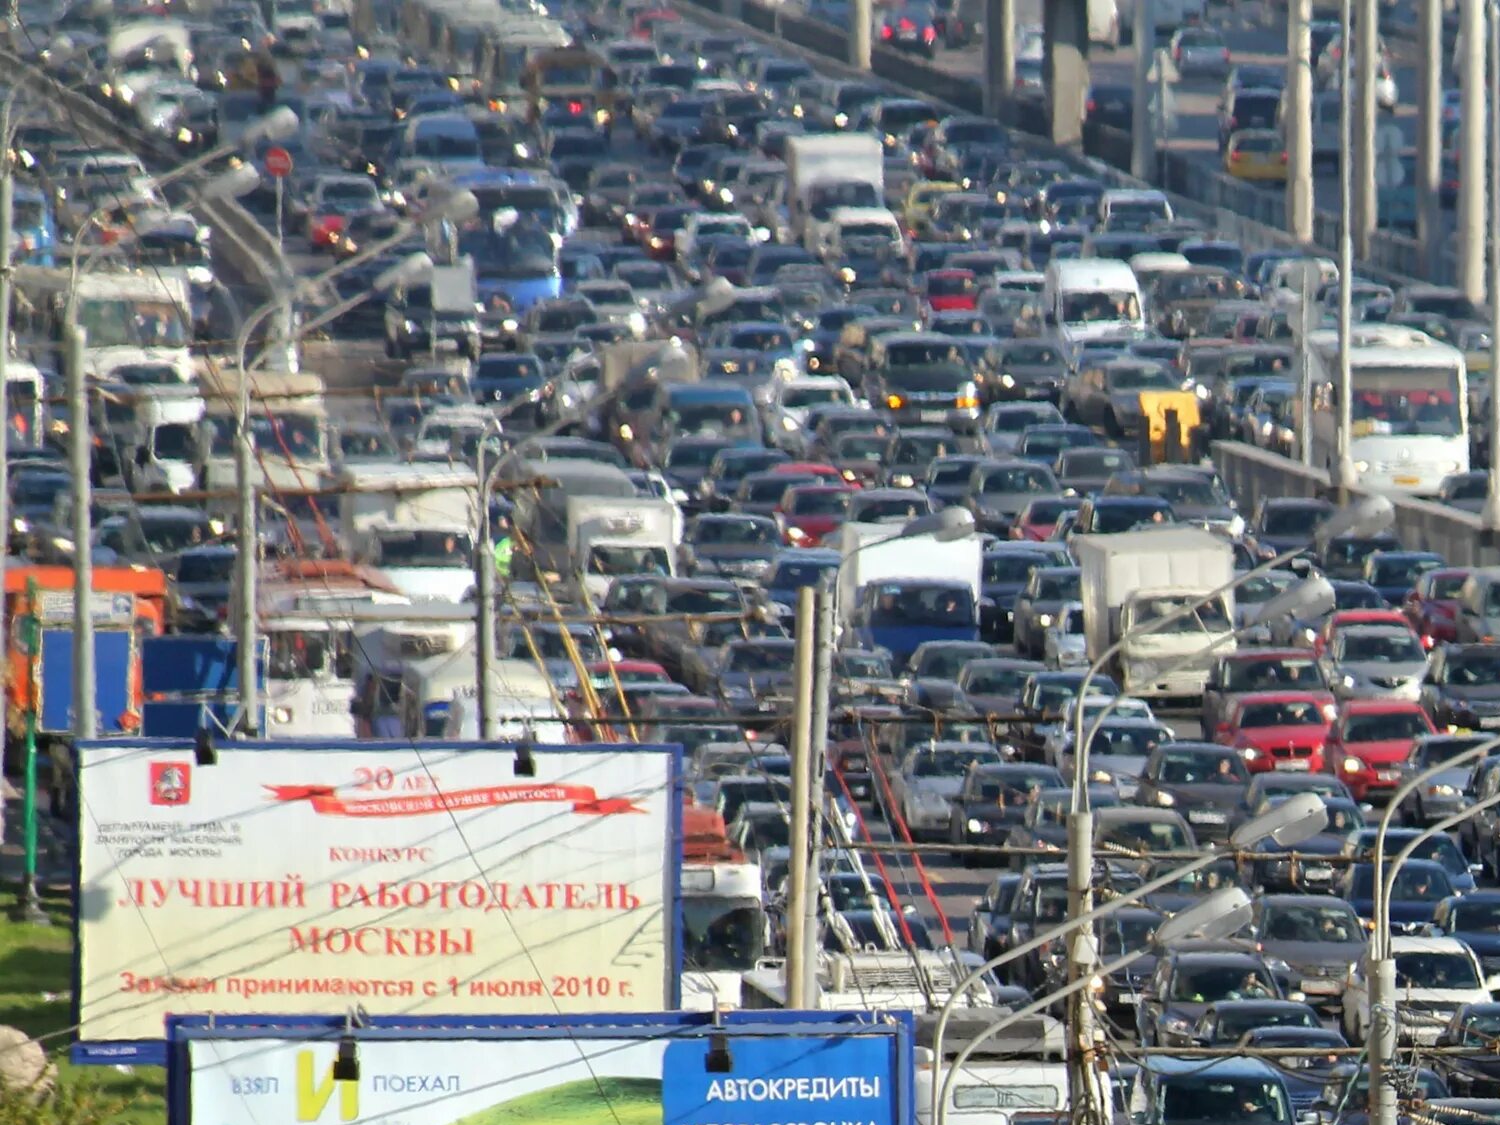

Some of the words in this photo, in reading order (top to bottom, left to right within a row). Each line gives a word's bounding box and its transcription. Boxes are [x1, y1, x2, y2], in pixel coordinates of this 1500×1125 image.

[352, 766, 394, 791] 20
[403, 773, 441, 790] ЛЕТ
[328, 847, 433, 863] КОНКУРС
[117, 873, 306, 908] ЛУЧШИЙ
[330, 881, 642, 912] РАБОТОДАТЕЛЬ
[289, 926, 474, 956] МОСКВЫ
[119, 971, 218, 996] Заявки
[226, 976, 414, 998] принимаются
[423, 979, 438, 997] с
[448, 975, 459, 997] 1
[469, 979, 543, 997] июля
[551, 976, 611, 997] 2010
[618, 980, 635, 997] г.
[231, 1077, 279, 1095] ВЗЯЛ
[295, 1049, 360, 1122] И
[372, 1075, 461, 1093] ПОЕХАЛ
[705, 1077, 880, 1102] АВТОКРЕДИТЫ
